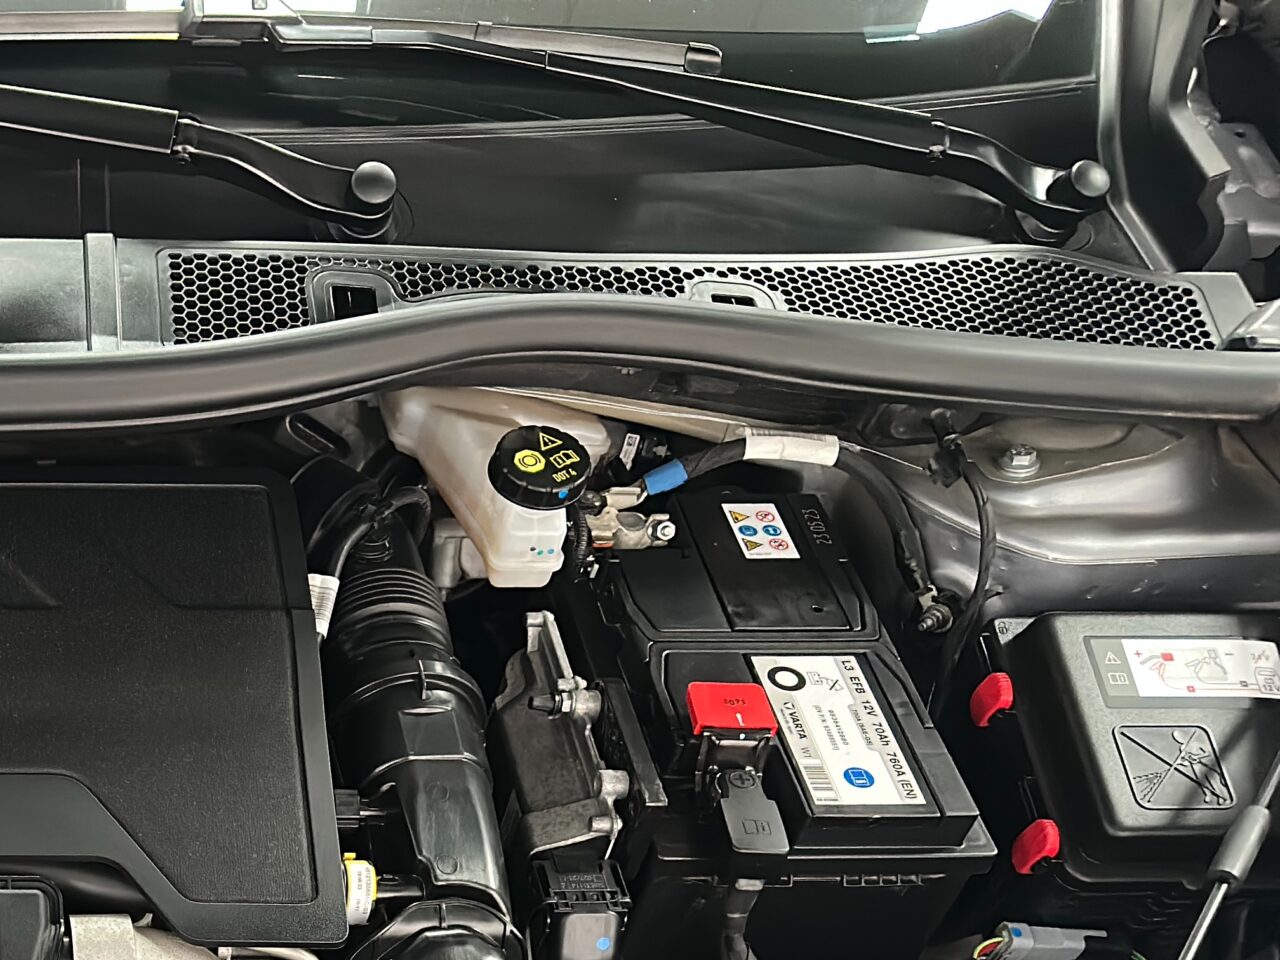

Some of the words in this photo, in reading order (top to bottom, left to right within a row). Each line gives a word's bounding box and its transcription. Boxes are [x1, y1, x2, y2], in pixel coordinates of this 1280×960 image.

[552, 470, 570, 483] DOT
[788, 710, 808, 740] VARTA
[841, 660, 854, 671] L3
[849, 676, 866, 694] EFB
[861, 700, 878, 717] 12V
[872, 722, 890, 746] 70Ah
[886, 752, 906, 777] 760A
[898, 779, 918, 799] (EN)
